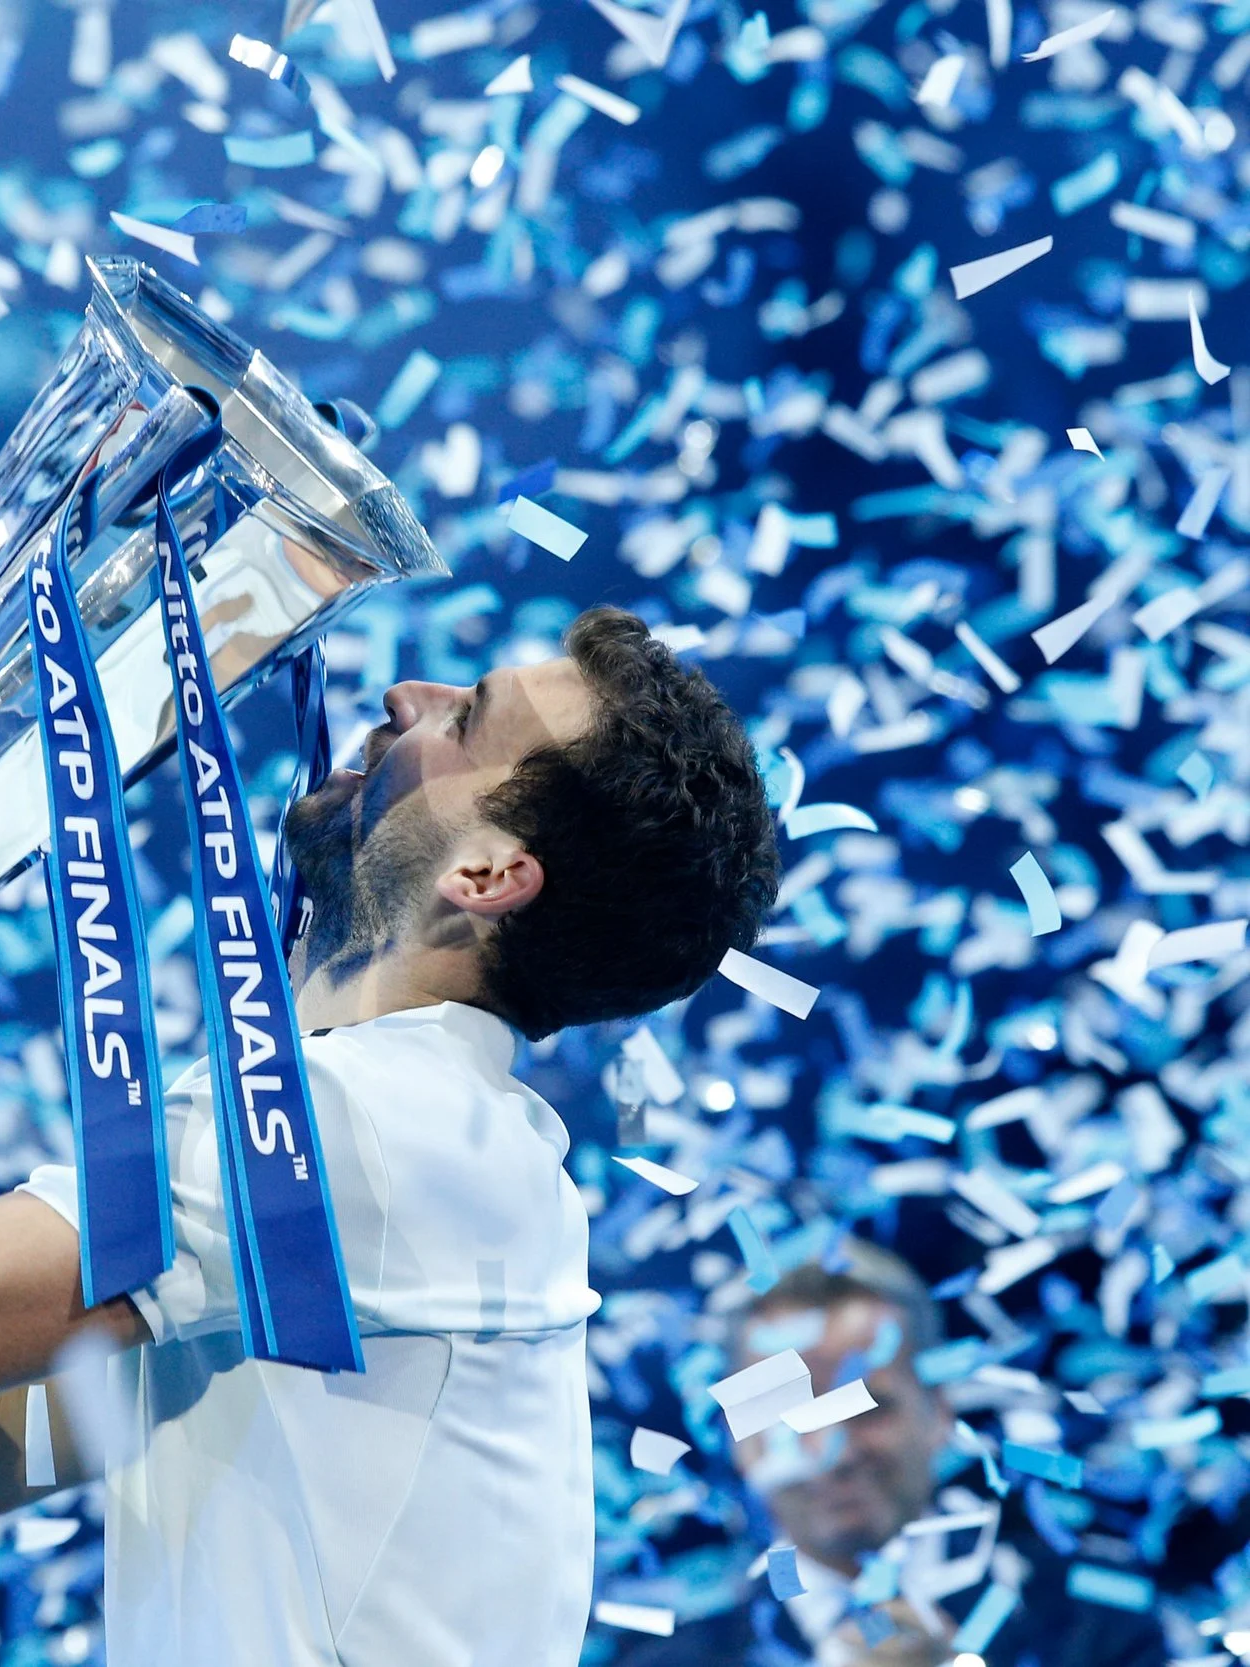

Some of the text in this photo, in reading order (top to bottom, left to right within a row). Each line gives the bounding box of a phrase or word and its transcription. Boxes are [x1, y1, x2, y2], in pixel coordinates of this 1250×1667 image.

[44, 654, 95, 800] ATP
[158, 541, 204, 726] Nitto
[188, 738, 238, 879] ATP
